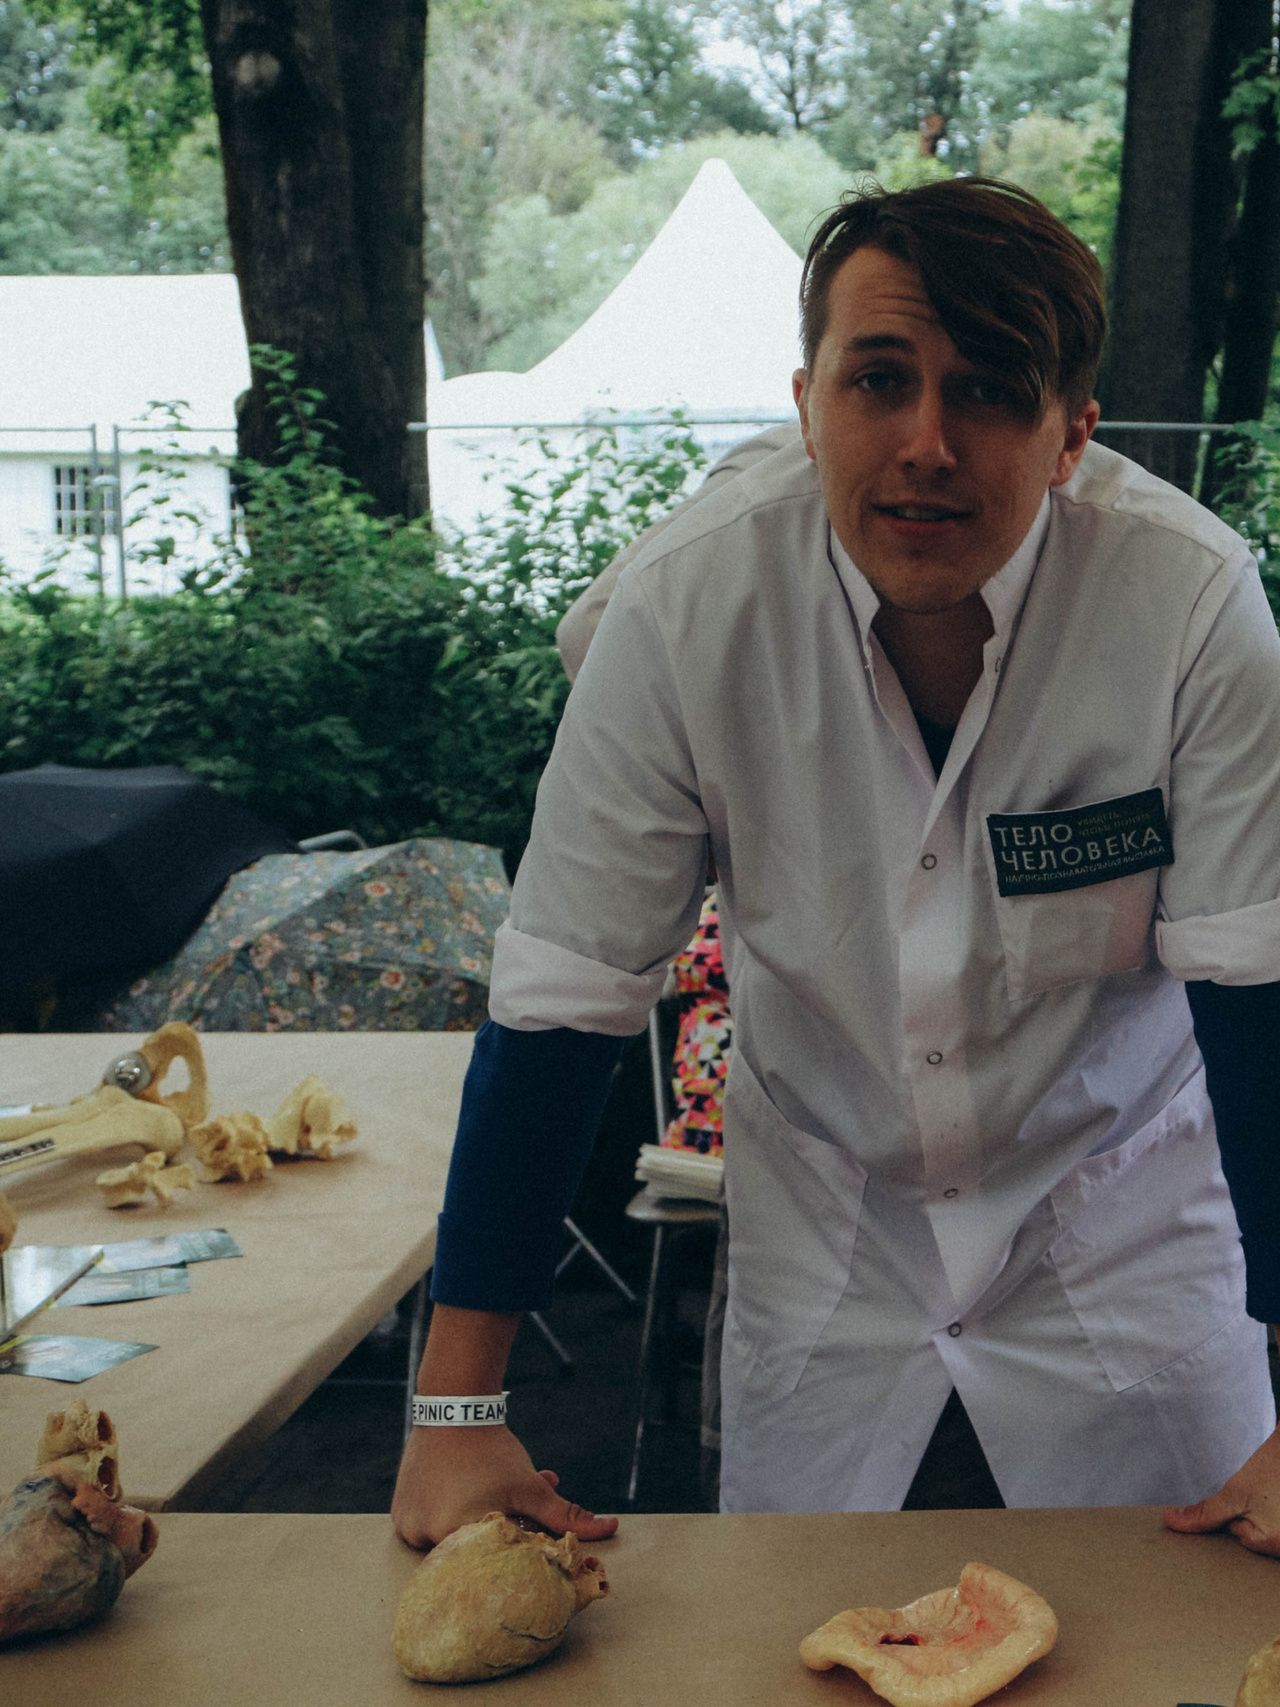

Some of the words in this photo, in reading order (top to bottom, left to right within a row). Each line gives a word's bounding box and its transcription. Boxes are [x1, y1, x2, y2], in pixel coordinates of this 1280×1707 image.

[994, 823, 1073, 847] ТЕЛО
[1000, 826, 1162, 871] ЧЕЛОВЕКА
[460, 1403, 505, 1420] TEAM
